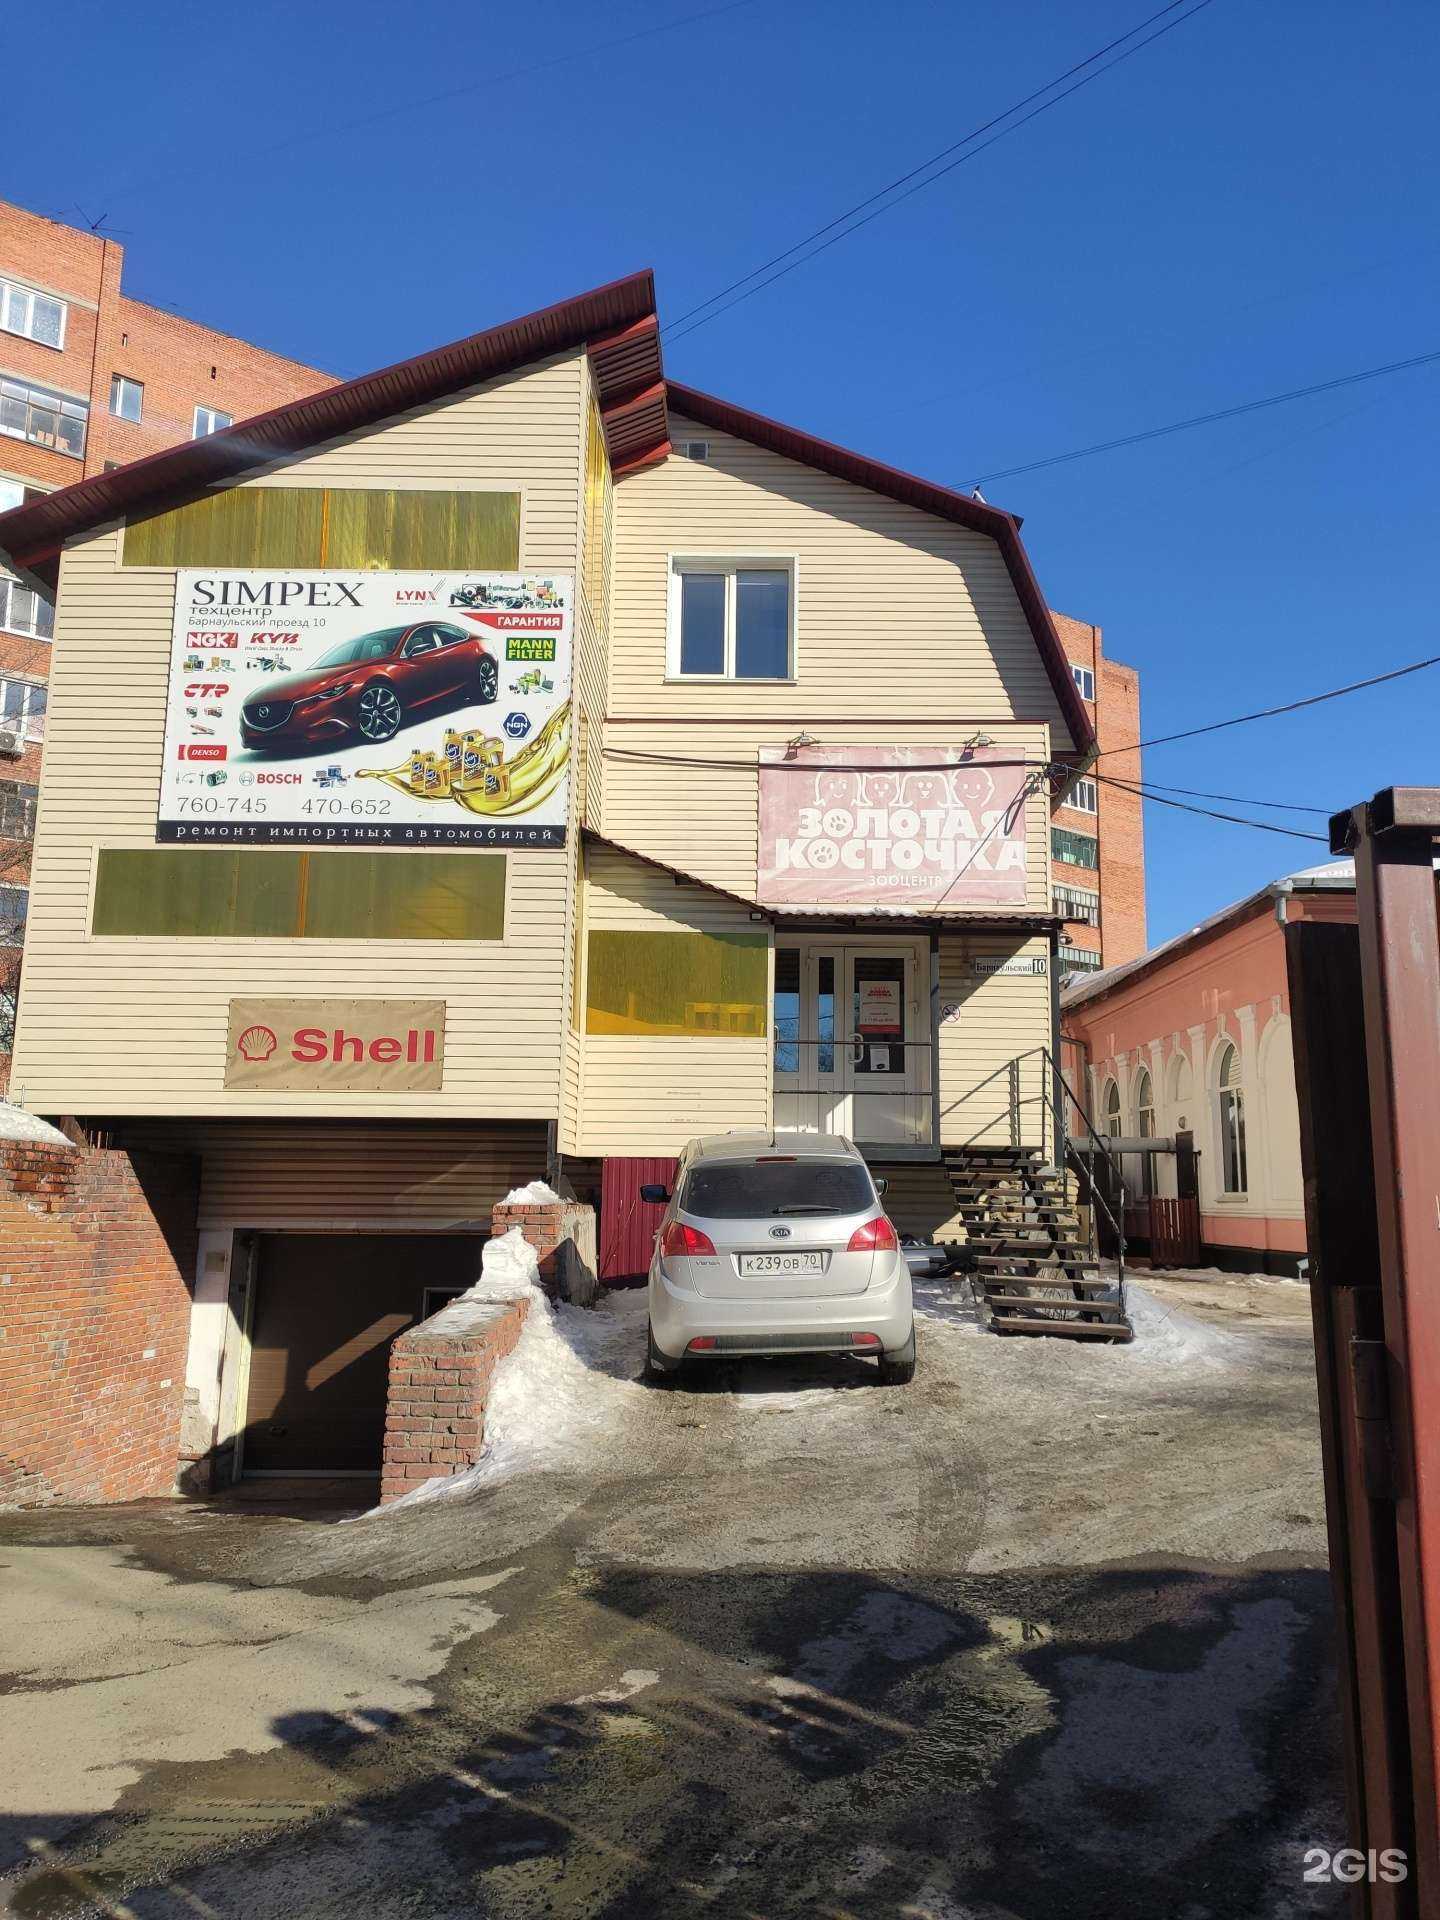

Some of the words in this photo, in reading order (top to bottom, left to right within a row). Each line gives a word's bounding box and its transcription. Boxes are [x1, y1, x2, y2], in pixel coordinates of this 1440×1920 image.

[192, 579, 365, 607] SIMPEX
[396, 589, 438, 601] LYNX
[191, 606, 272, 618] техцентр
[188, 616, 266, 627] Барнаульский
[269, 618, 309, 628] проезд
[313, 618, 326, 628] 10
[497, 616, 561, 627] ГАРАНТИЯ
[187, 633, 230, 648] NGK
[250, 632, 299, 644] KYB
[508, 639, 554, 650] MANN
[508, 649, 553, 660] FILTER
[507, 721, 528, 729] NGN
[191, 749, 220, 757] DENSO
[256, 773, 302, 785] BOSCH
[177, 797, 267, 814] 760-745
[301, 799, 391, 815] 470-652
[798, 807, 1014, 841] ЗОЛОТАЯ
[176, 825, 257, 840] ремонт
[270, 827, 392, 840] импортных
[405, 827, 552, 840] автомобилей
[775, 838, 1026, 871] КОСТОЧКА
[869, 875, 944, 888] ЗООЦЕНТР
[1033, 959, 1046, 973] 10
[291, 1028, 435, 1063] Shell
[774, 1229, 790, 1237] KIA
[803, 1254, 817, 1266] 70
